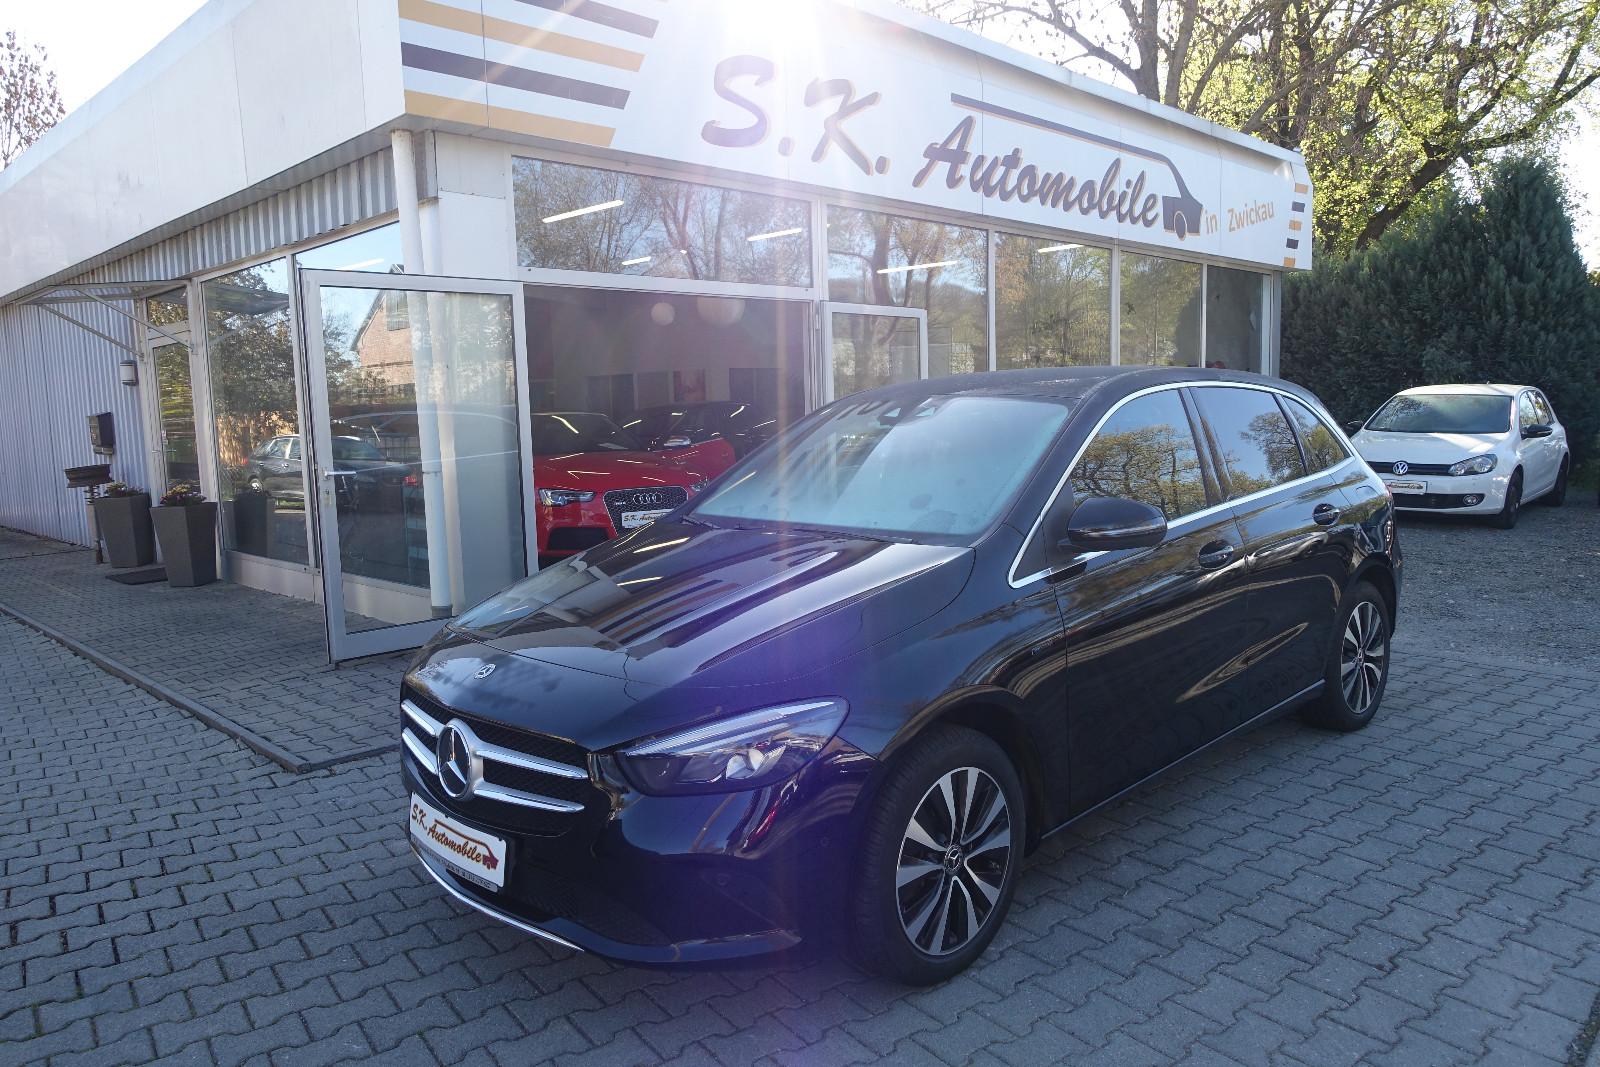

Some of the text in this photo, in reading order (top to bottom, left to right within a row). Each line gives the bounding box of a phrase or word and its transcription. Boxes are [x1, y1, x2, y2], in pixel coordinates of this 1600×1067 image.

[701, 55, 1275, 235] S.K. Automobile in Zwickau
[427, 823, 481, 862] Automobile
